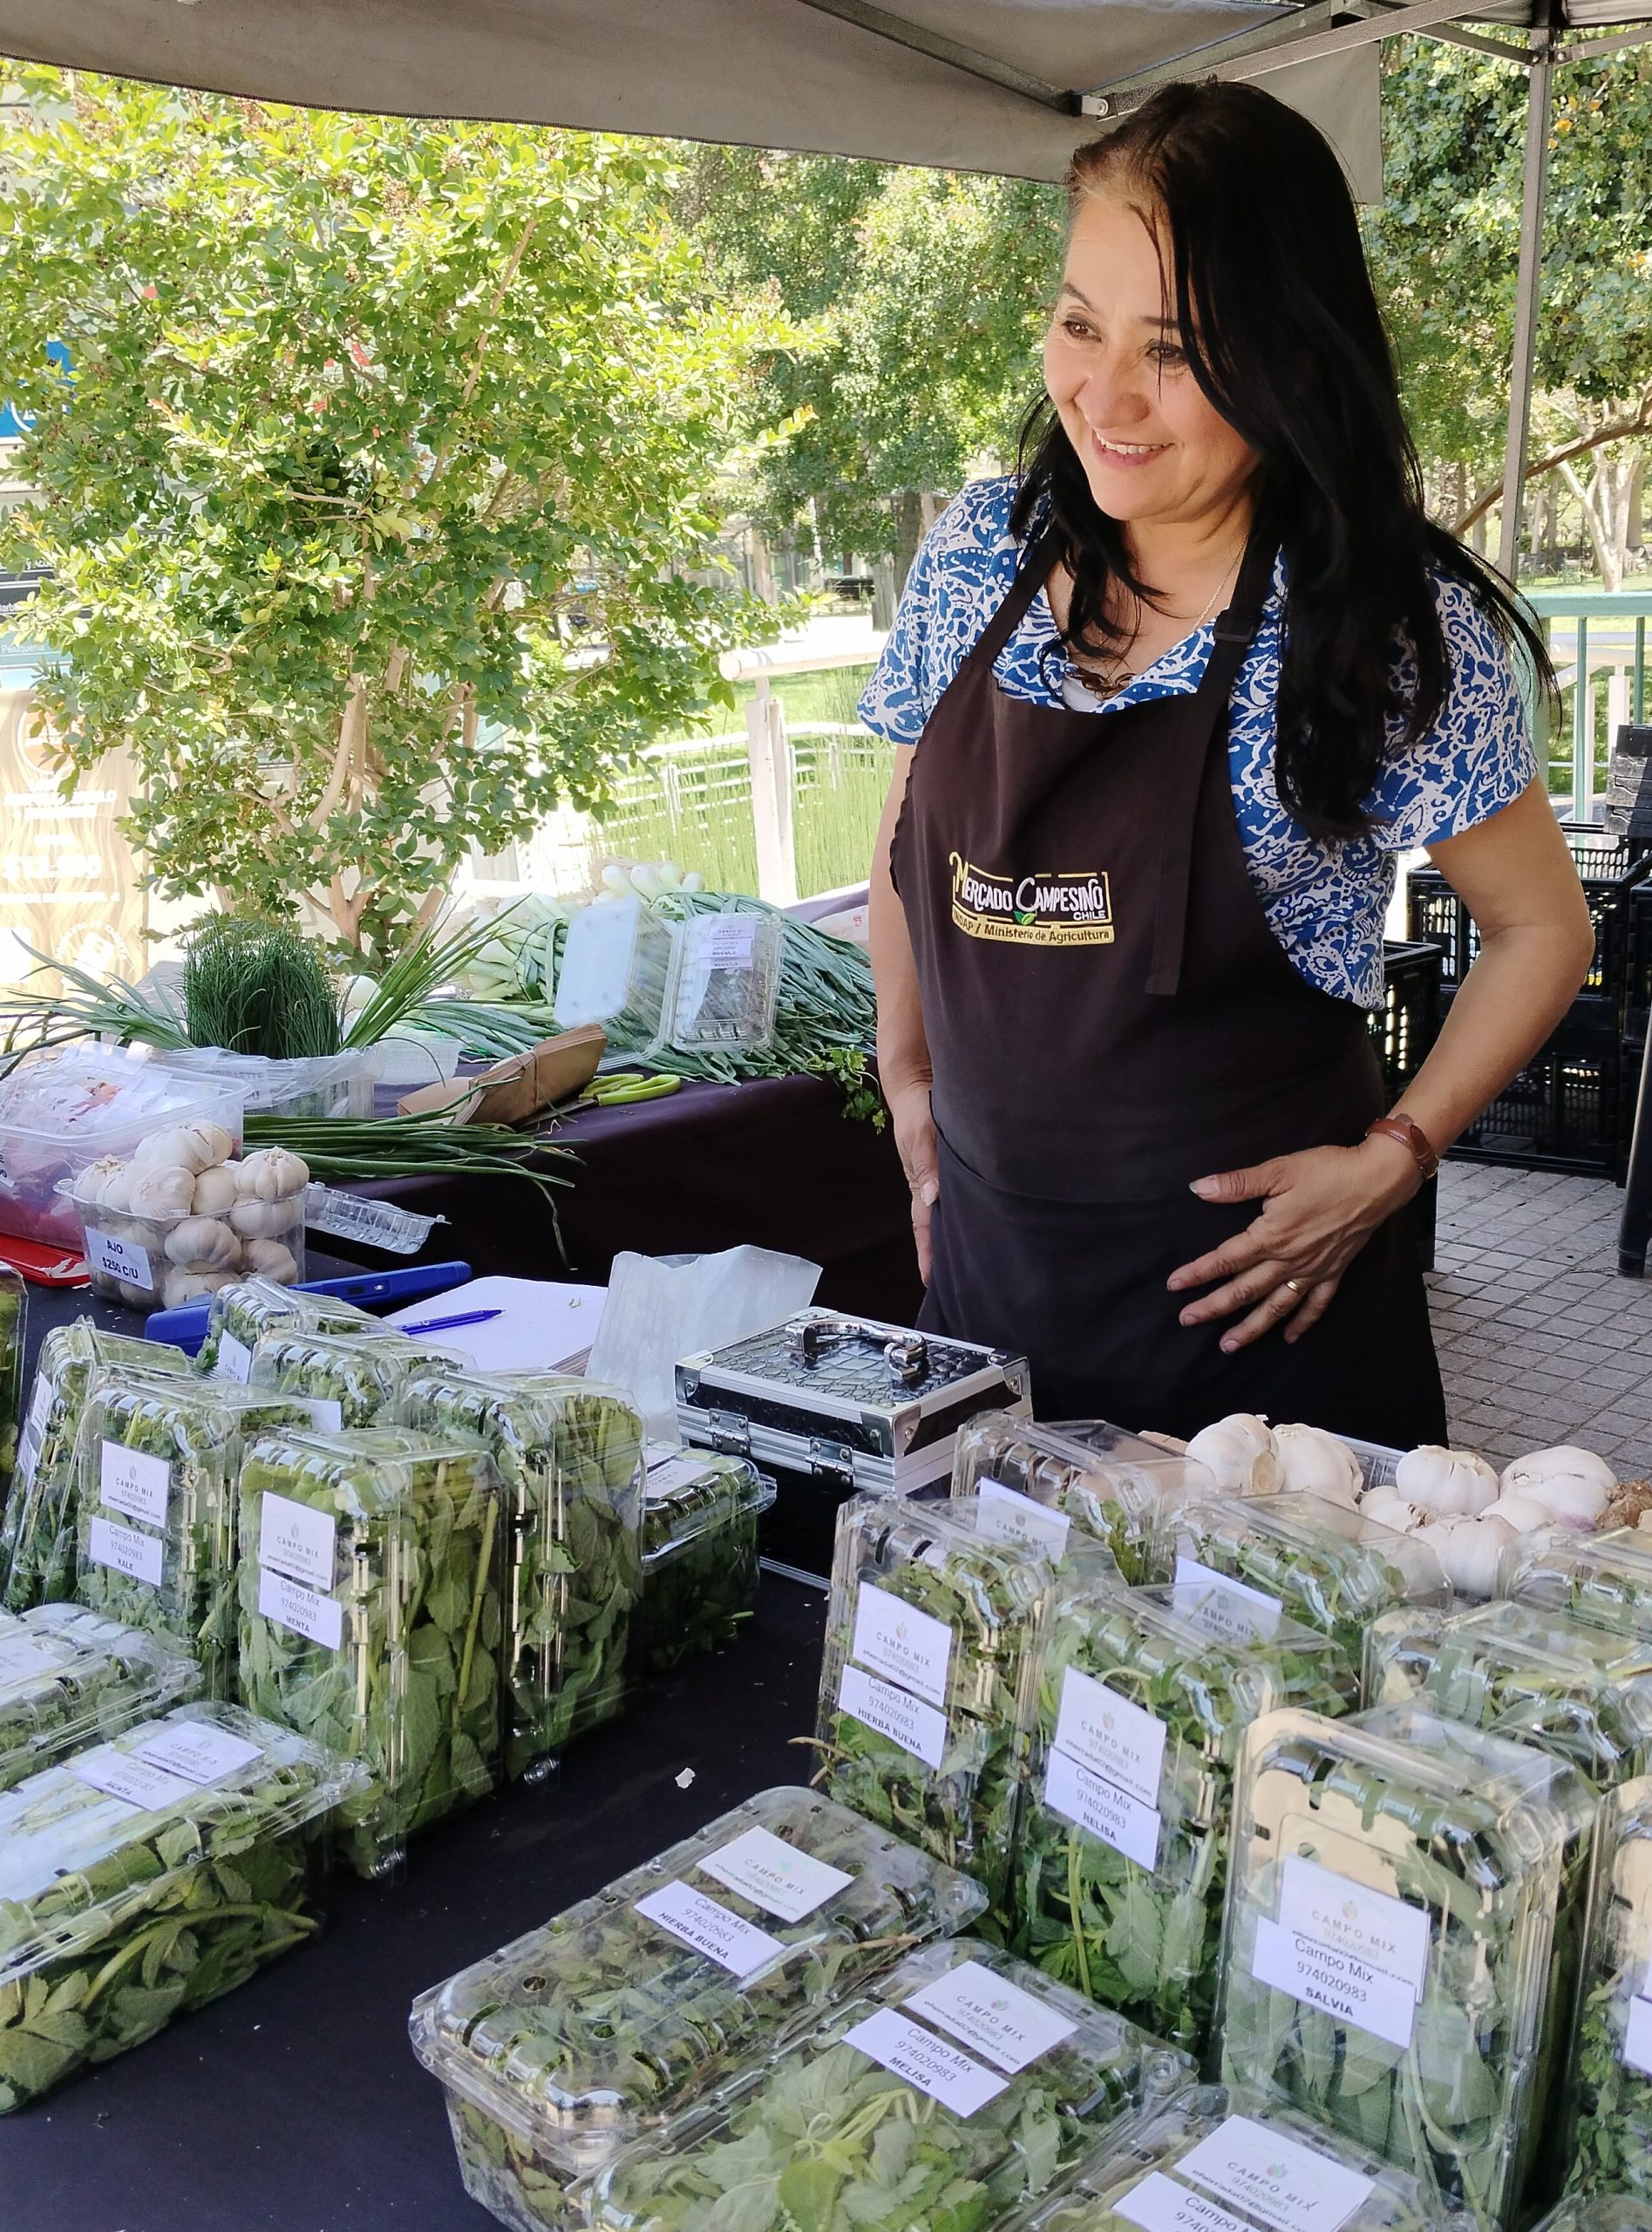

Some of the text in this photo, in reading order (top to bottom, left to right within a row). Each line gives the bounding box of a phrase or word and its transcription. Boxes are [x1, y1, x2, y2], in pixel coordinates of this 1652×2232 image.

[954, 910, 974, 934] INDAP
[984, 924, 1033, 939] Ministerio
[1036, 931, 1046, 941] de
[1049, 929, 1110, 943] Agricultura
[1073, 911, 1106, 921] CHILE
[106, 1240, 124, 1255] AJO
[102, 1256, 139, 1279] $250 C/U
[116, 1477, 153, 1498] CAMPO MIX
[109, 1525, 145, 1548] Campo Mix
[110, 1541, 143, 1562] 974020983
[276, 1536, 319, 1558] CAMPO MIX
[118, 1558, 133, 1571] KALE
[280, 1581, 320, 1606] Campo Mix
[280, 1597, 316, 1622] 974020983
[286, 1615, 310, 1633] MENTA
[876, 1631, 930, 1668] CAMPO MIX
[868, 1676, 920, 1714] Campo Mix
[858, 1707, 921, 1752] HIERBA BUENA
[869, 1696, 914, 1730] 974020983
[1081, 1719, 1141, 1764] CAMPO MIX
[125, 1762, 156, 1779] Campo
[105, 1780, 133, 1796] MENTA
[1076, 1768, 1132, 1812] Campo Mix
[1077, 1790, 1126, 1829] 974020983
[1083, 1811, 1117, 1841] MELISA
[744, 1859, 806, 1895] CAMPO MIX
[682, 1908, 734, 1943] 974020983
[695, 1897, 751, 1936] Campo Mix
[1312, 1909, 1397, 1954] CAMPO MIX
[658, 1912, 729, 1960] HIERBA BUENA
[1295, 1938, 1375, 1984] Campo Mix
[1297, 1962, 1367, 2003] 974020983
[1305, 1986, 1354, 2017] SALVIA
[956, 1996, 1026, 2042] CAMPO MIX
[894, 2040, 956, 2082] 974020983
[908, 2028, 976, 2074] Campo Mix
[889, 2057, 933, 2086] MELISA
[1227, 2161, 1319, 2211] CAMPO MIX
[1186, 2196, 1238, 2231] Campo
